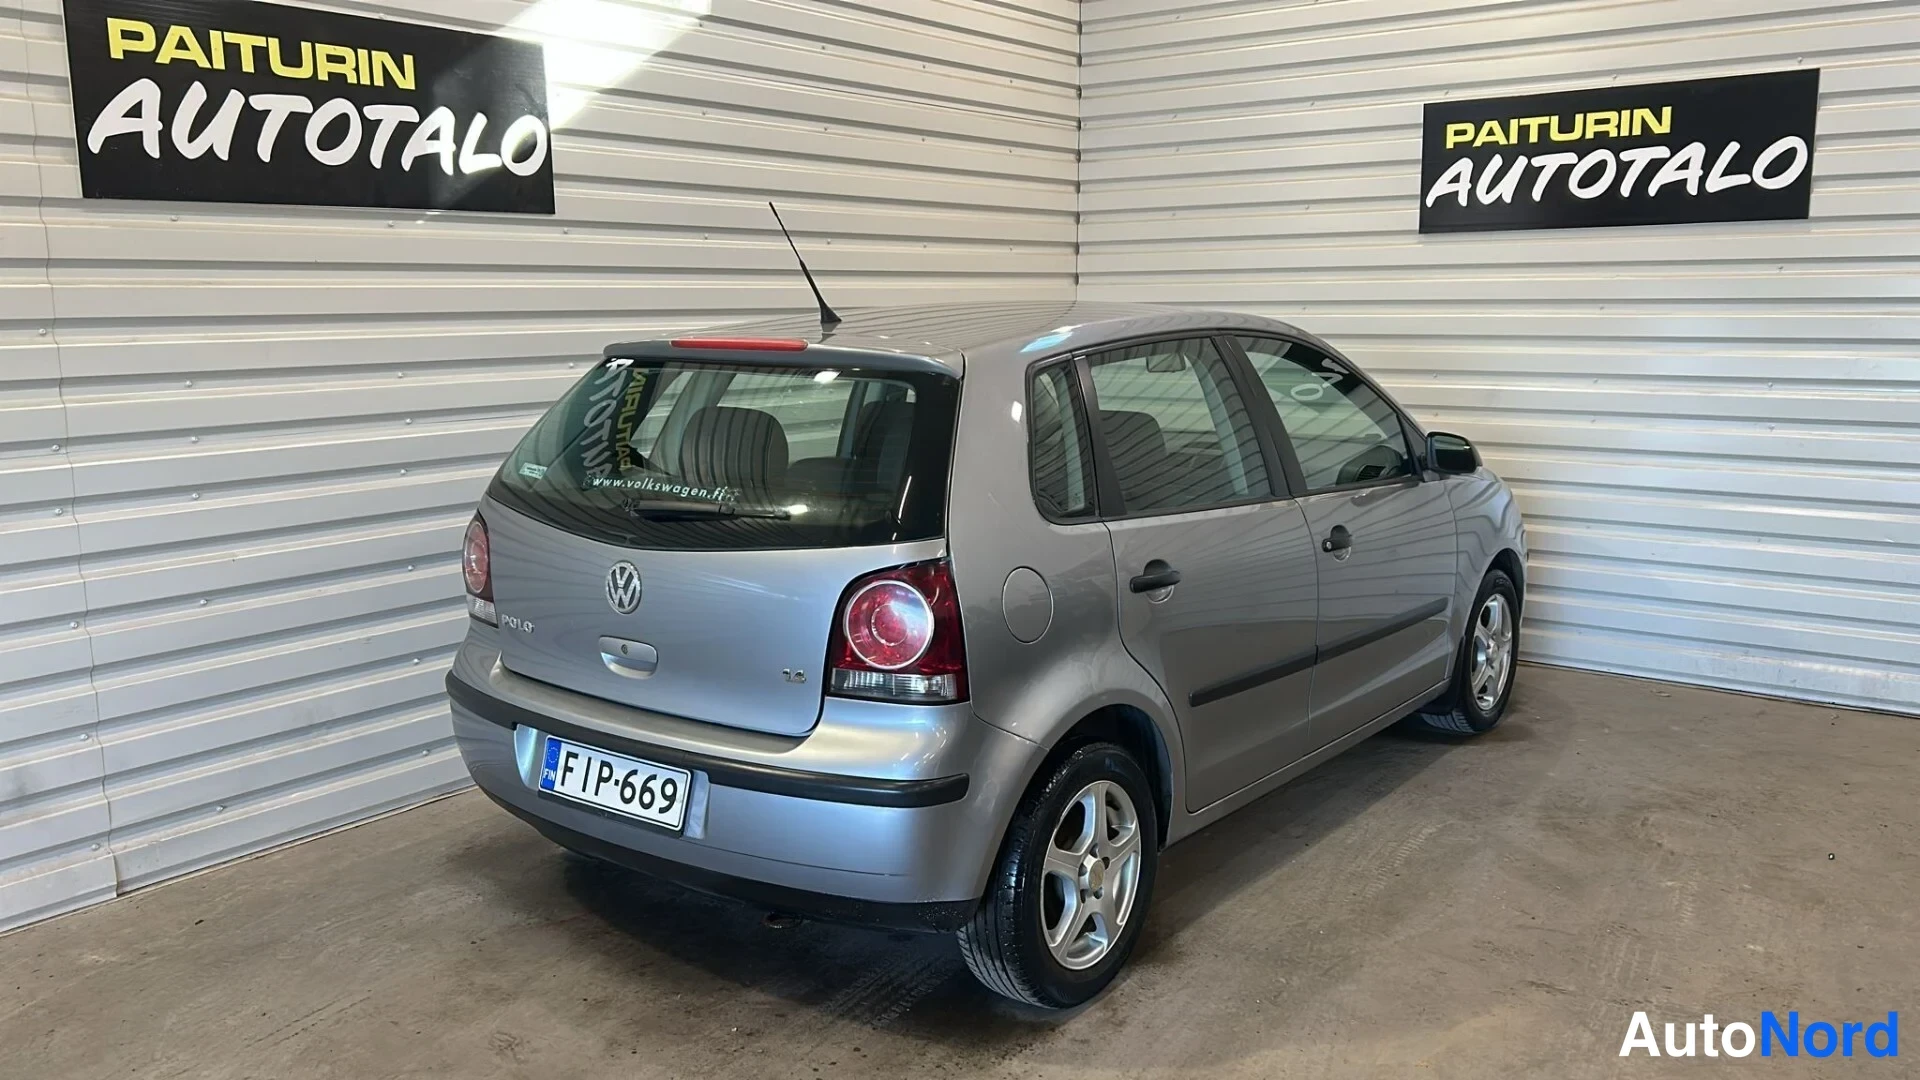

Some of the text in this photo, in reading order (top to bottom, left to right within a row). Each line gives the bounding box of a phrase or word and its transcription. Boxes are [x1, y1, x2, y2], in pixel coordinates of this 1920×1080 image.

[106, 17, 417, 90] PAITURIN
[87, 78, 548, 177] AUTOTALO
[1445, 106, 1673, 149] PAITURIN
[1425, 136, 1809, 208] AUTOTALO
[592, 477, 728, 502] www.volkswagen.fi
[501, 614, 534, 633] POLO
[542, 768, 557, 782] FIN
[560, 751, 678, 814] FIP-669
